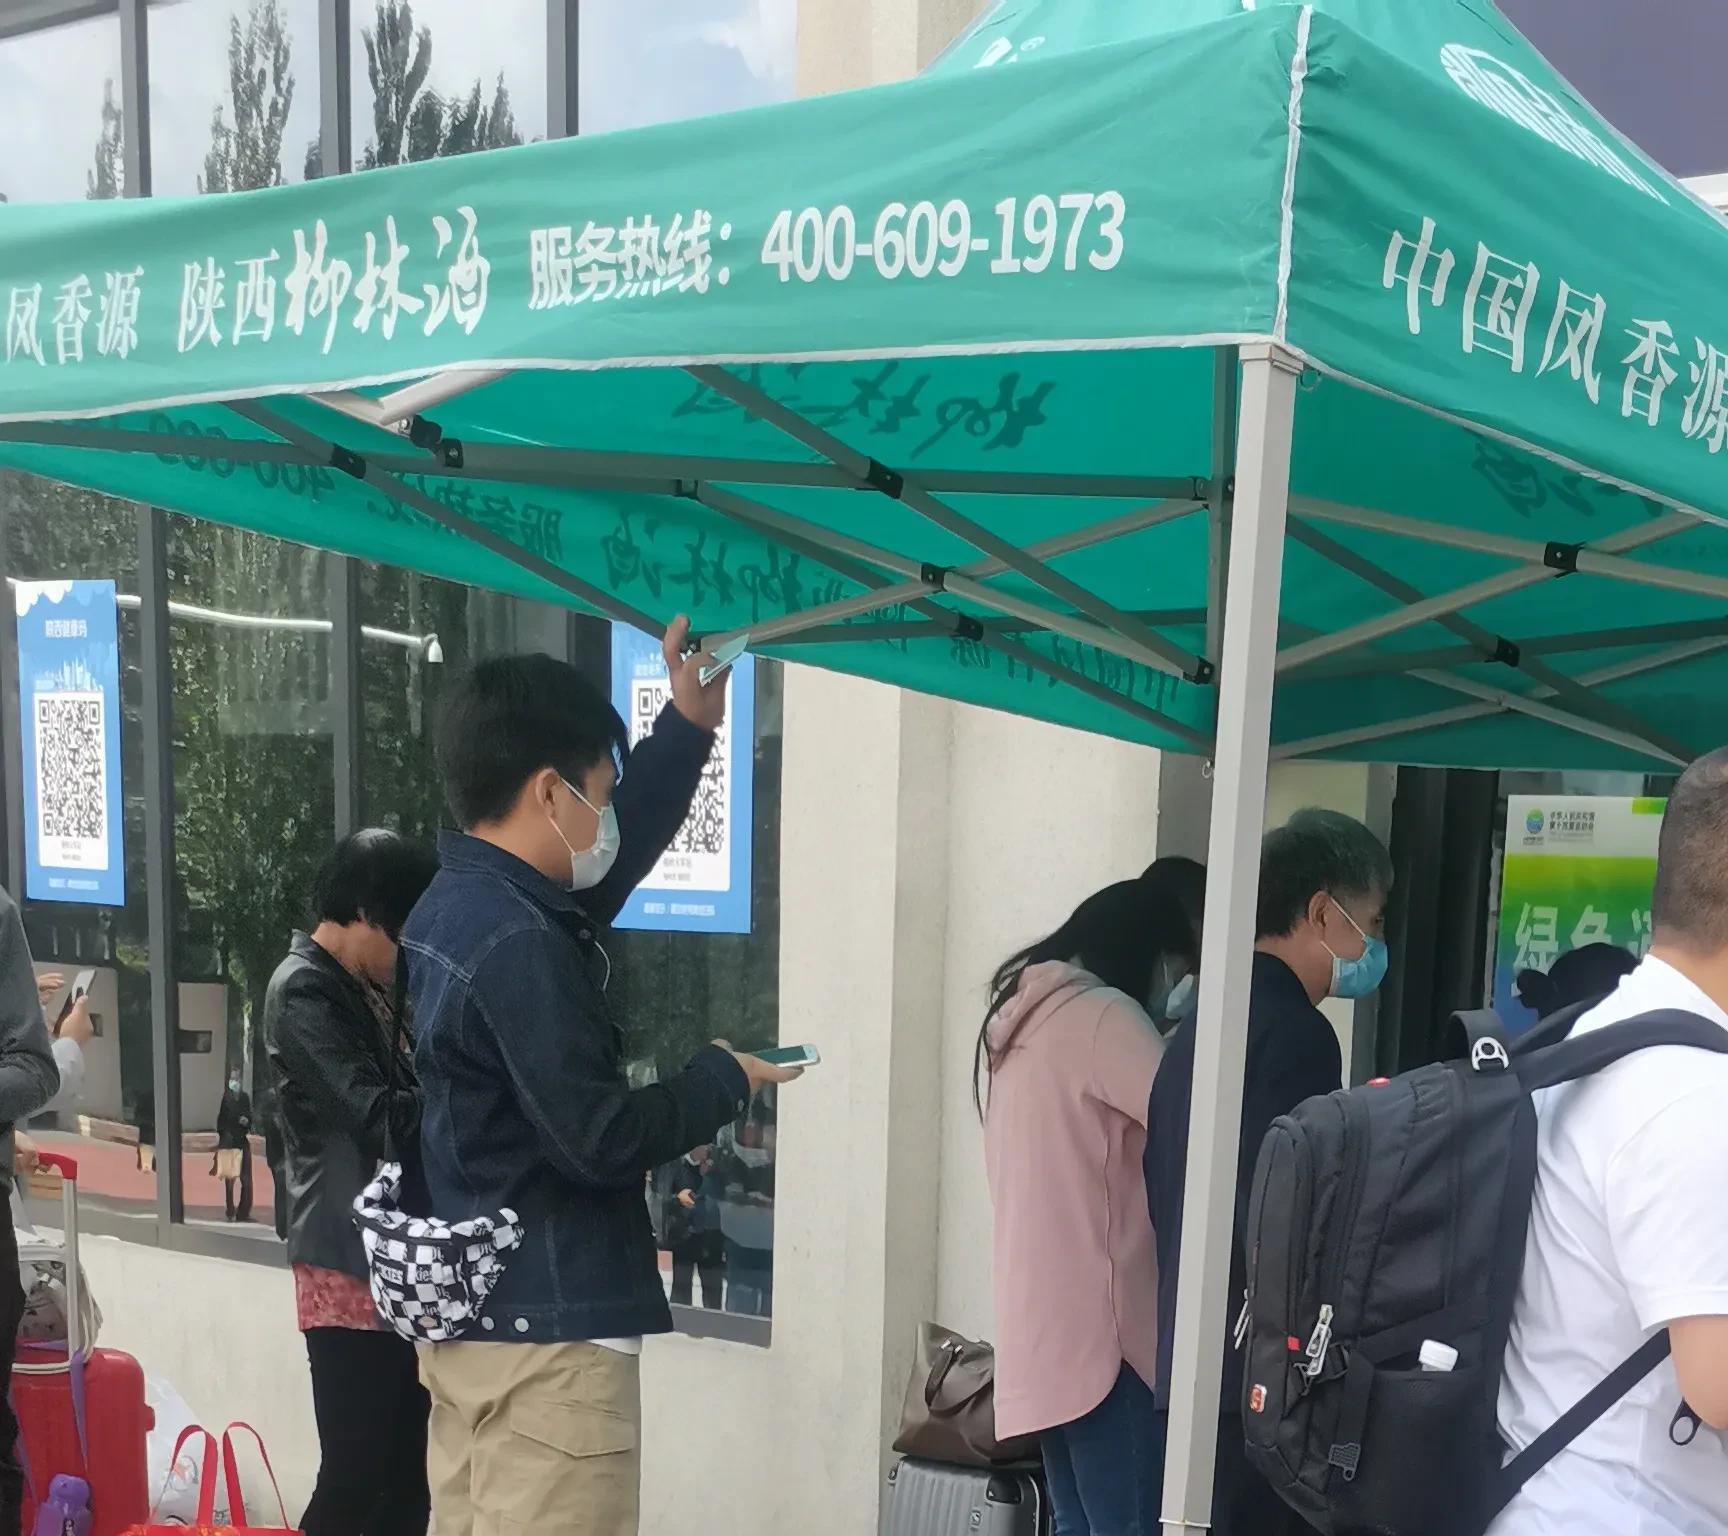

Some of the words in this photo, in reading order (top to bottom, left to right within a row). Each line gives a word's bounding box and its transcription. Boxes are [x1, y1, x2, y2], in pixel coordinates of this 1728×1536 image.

[5, 266, 145, 367] 凤香源
[178, 206, 491, 355] 陕西柳林酒
[761, 190, 1126, 283] 400-609-1973
